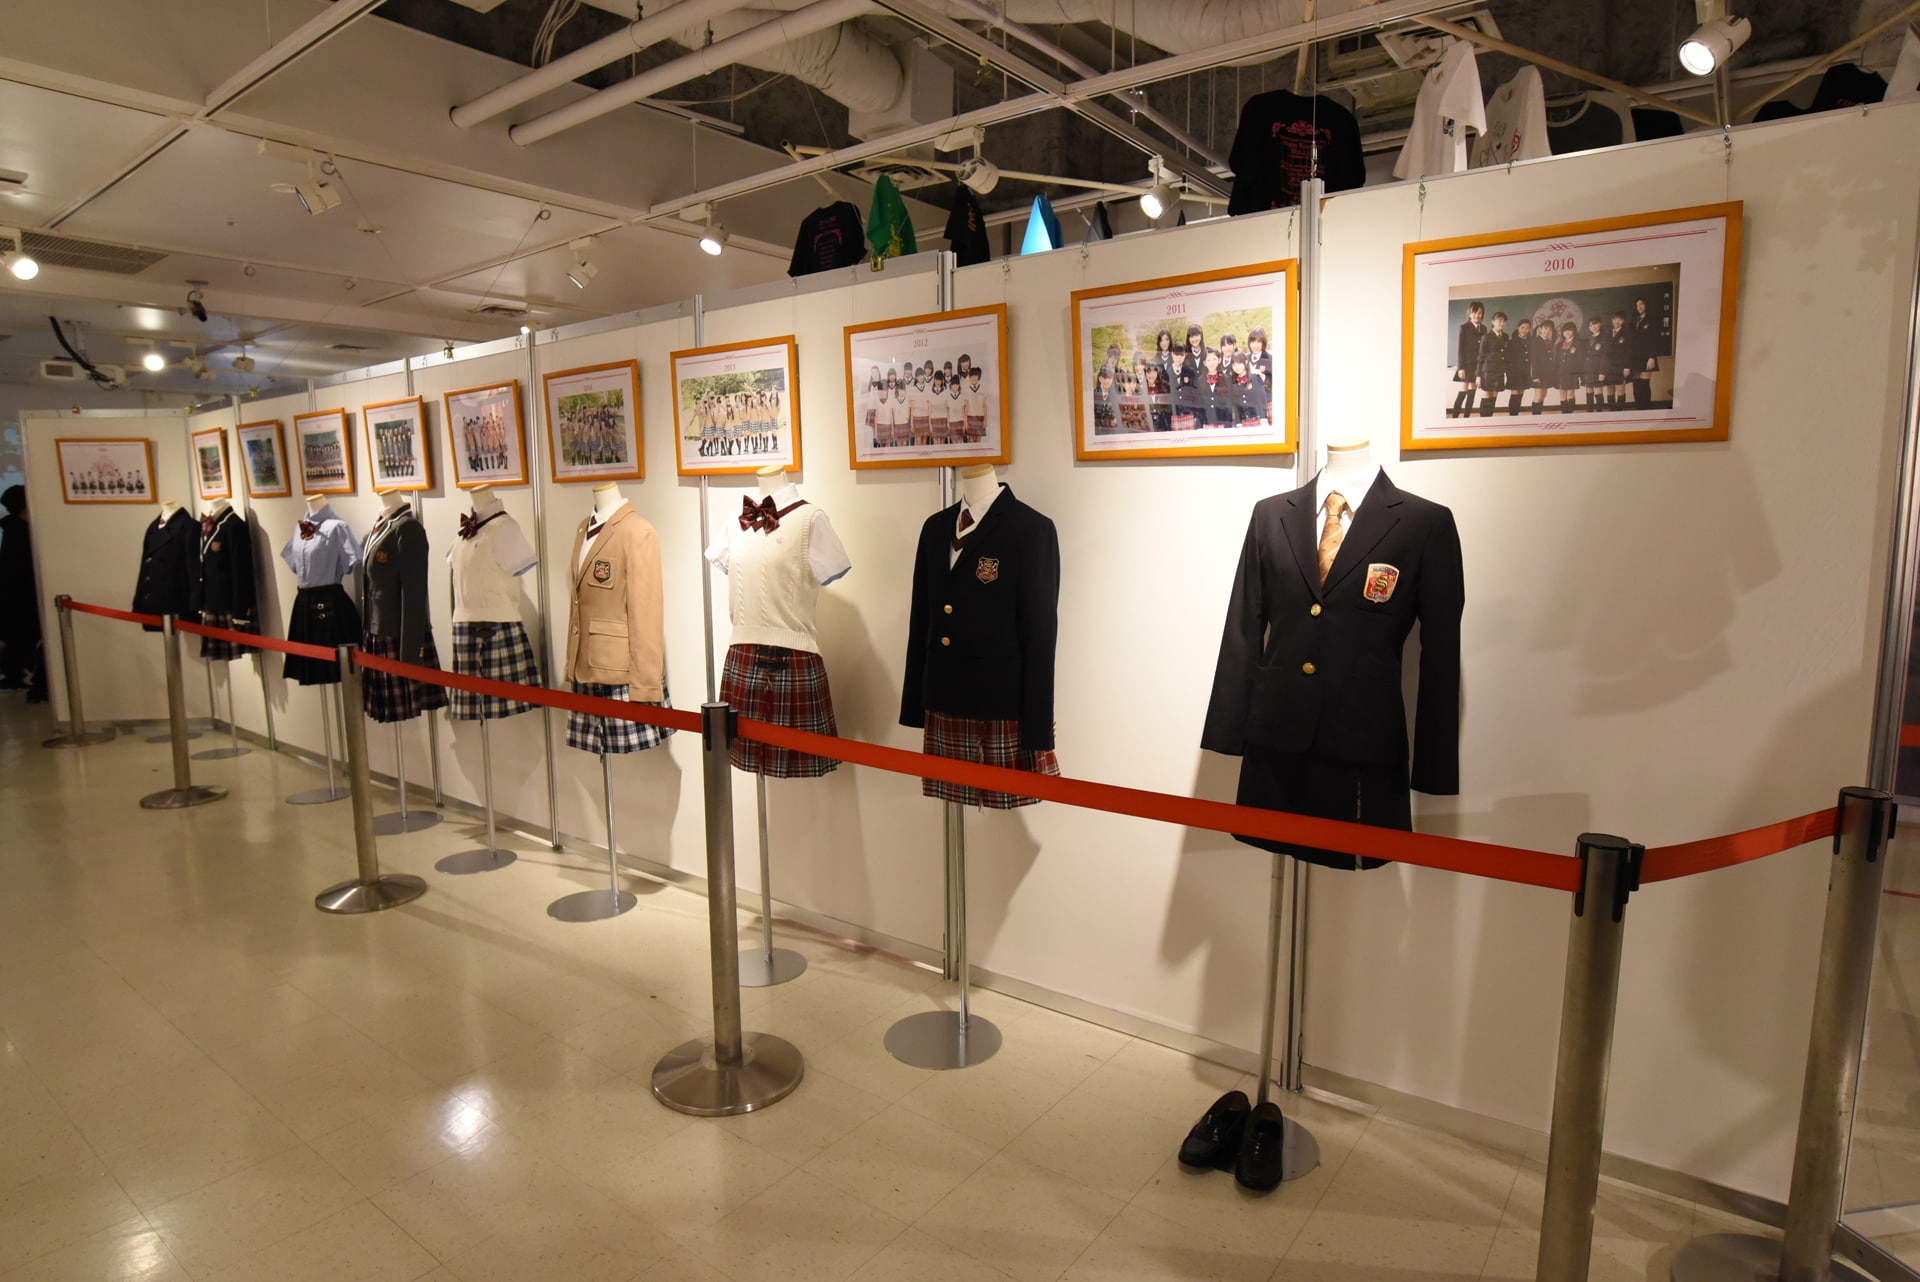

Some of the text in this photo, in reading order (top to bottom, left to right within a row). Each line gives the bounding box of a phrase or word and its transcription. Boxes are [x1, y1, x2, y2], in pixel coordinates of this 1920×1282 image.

[1544, 257, 1575, 272] 2010
[1166, 303, 1186, 315] 2011
[913, 338, 929, 348] 2012
